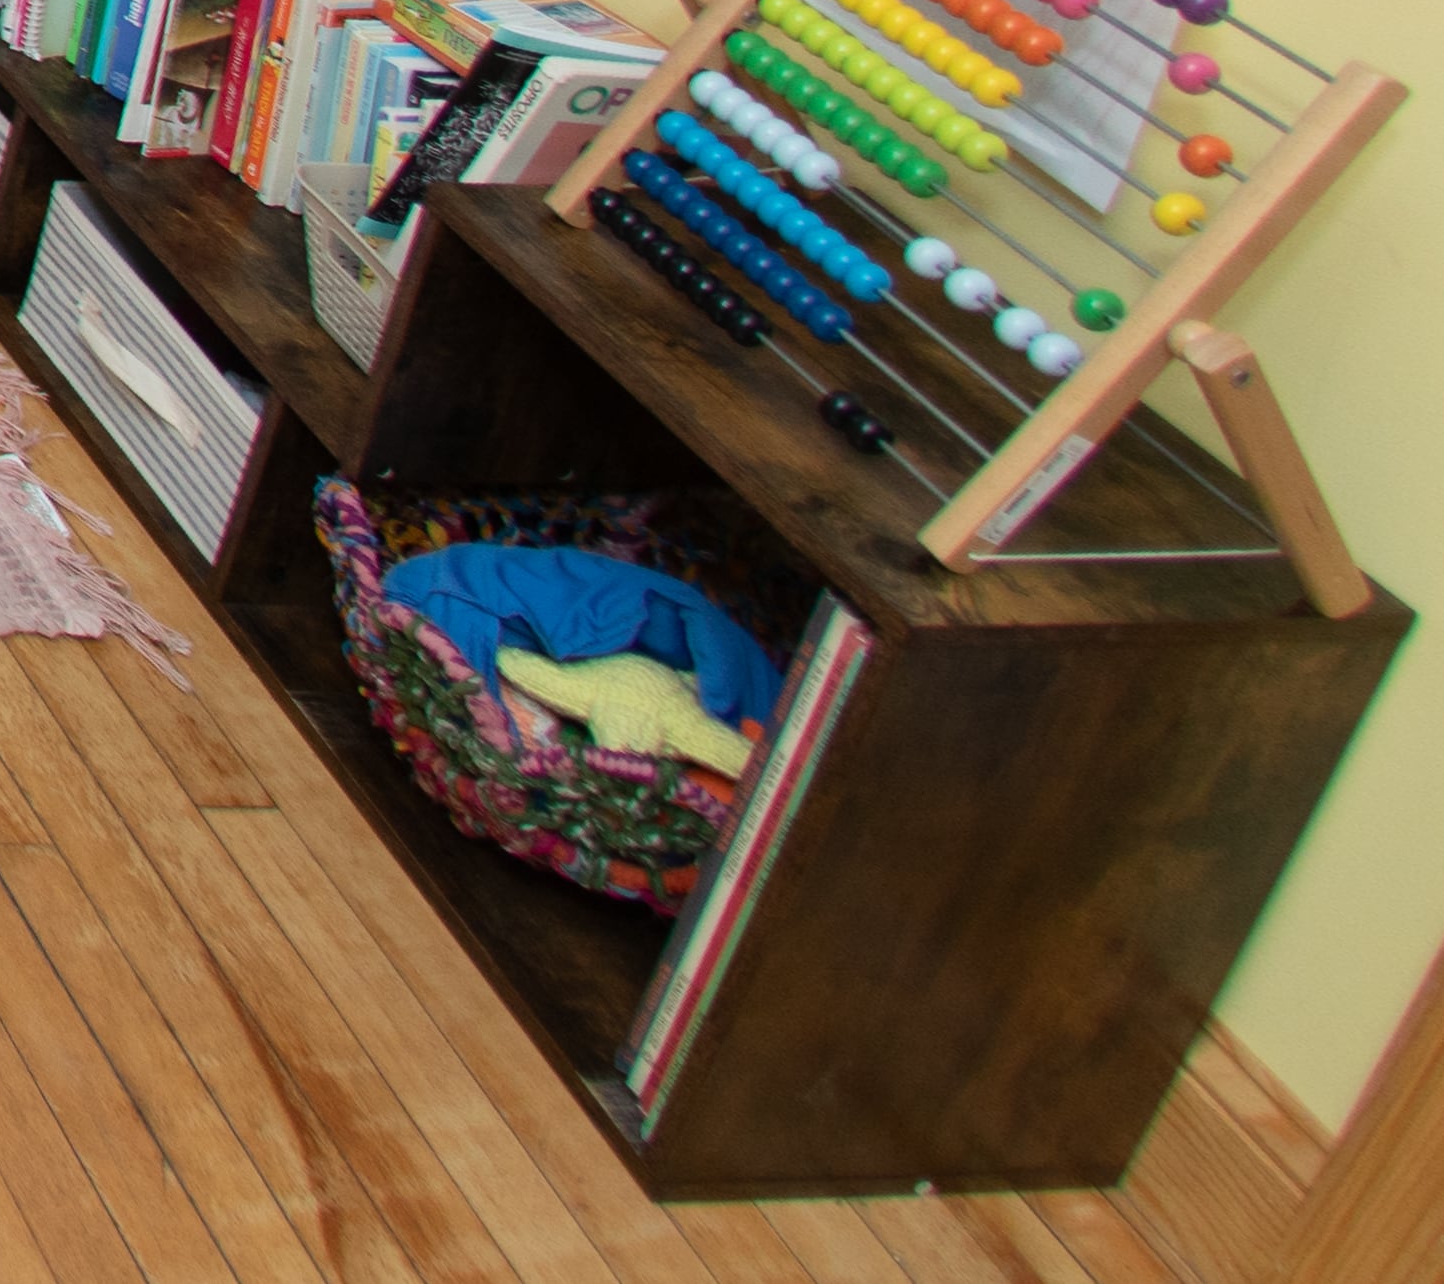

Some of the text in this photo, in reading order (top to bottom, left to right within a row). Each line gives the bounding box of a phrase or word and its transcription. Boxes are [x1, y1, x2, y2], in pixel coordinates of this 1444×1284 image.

[497, 78, 543, 142] OPPOSITES
[568, 84, 634, 117] OP
[764, 749, 786, 789] BABAR
[753, 789, 772, 813] AND
[723, 832, 751, 884] CHILDREN
[665, 971, 688, 1014] RANDOM
